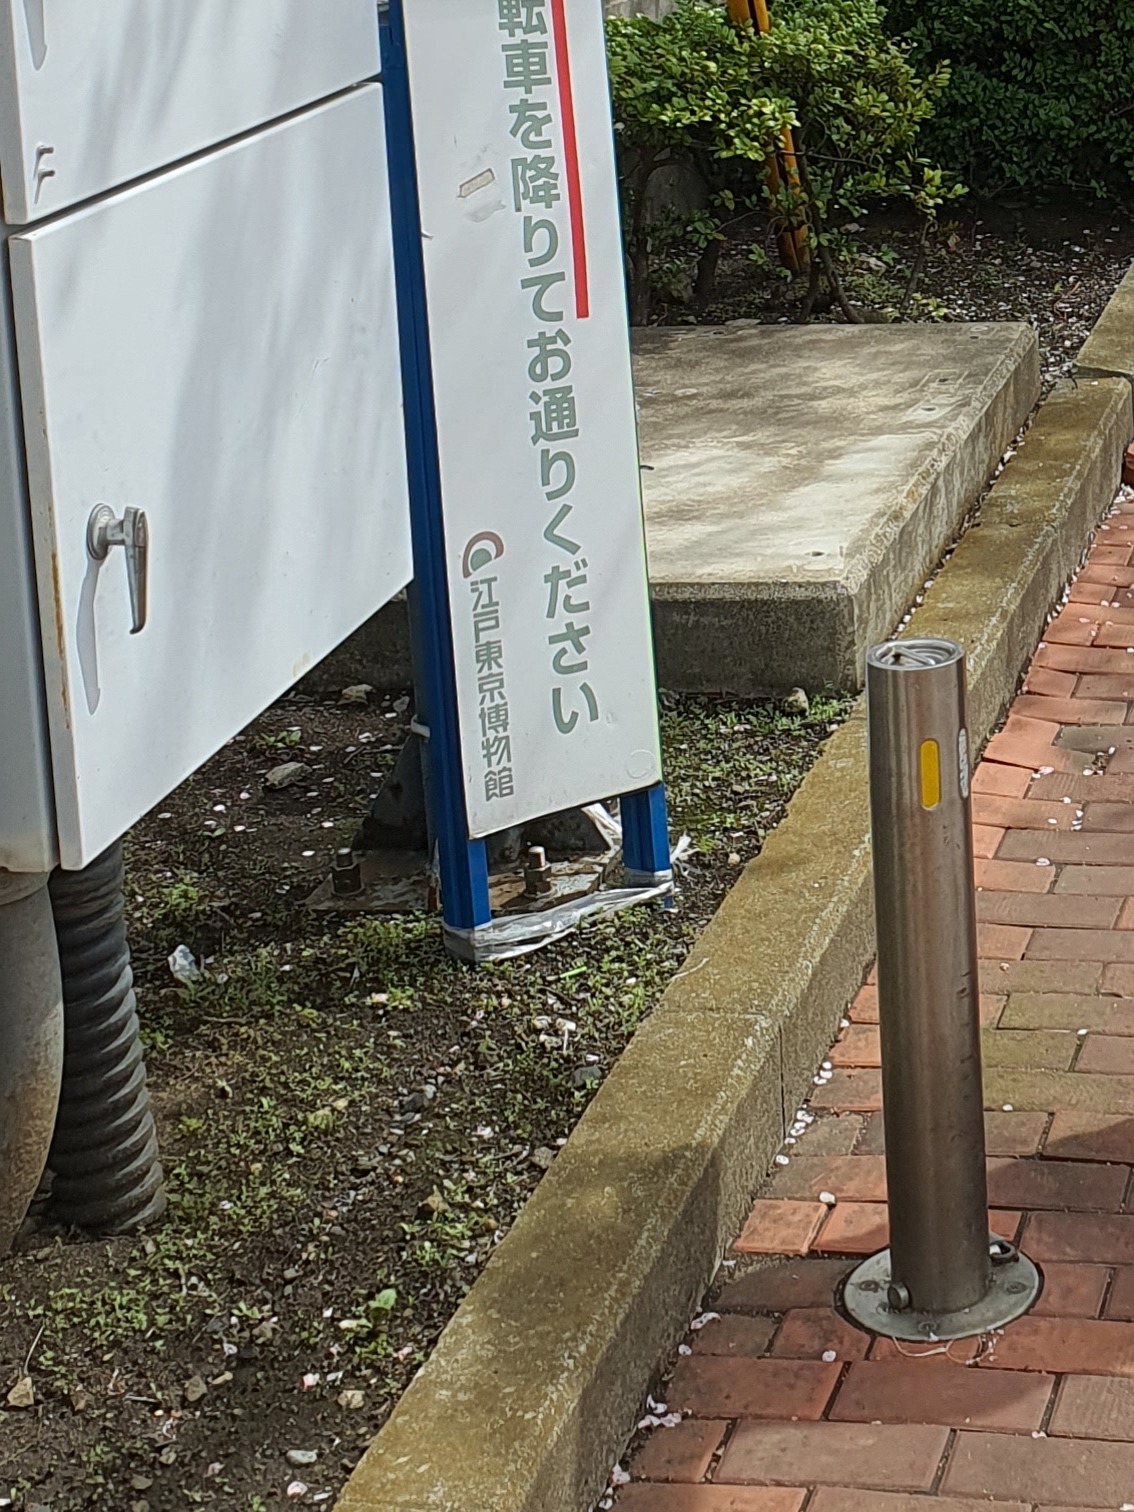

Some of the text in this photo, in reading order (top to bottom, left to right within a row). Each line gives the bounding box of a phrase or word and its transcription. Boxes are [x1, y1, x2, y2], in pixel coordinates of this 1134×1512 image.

[469, 577, 514, 803] 江戸東京博物館
